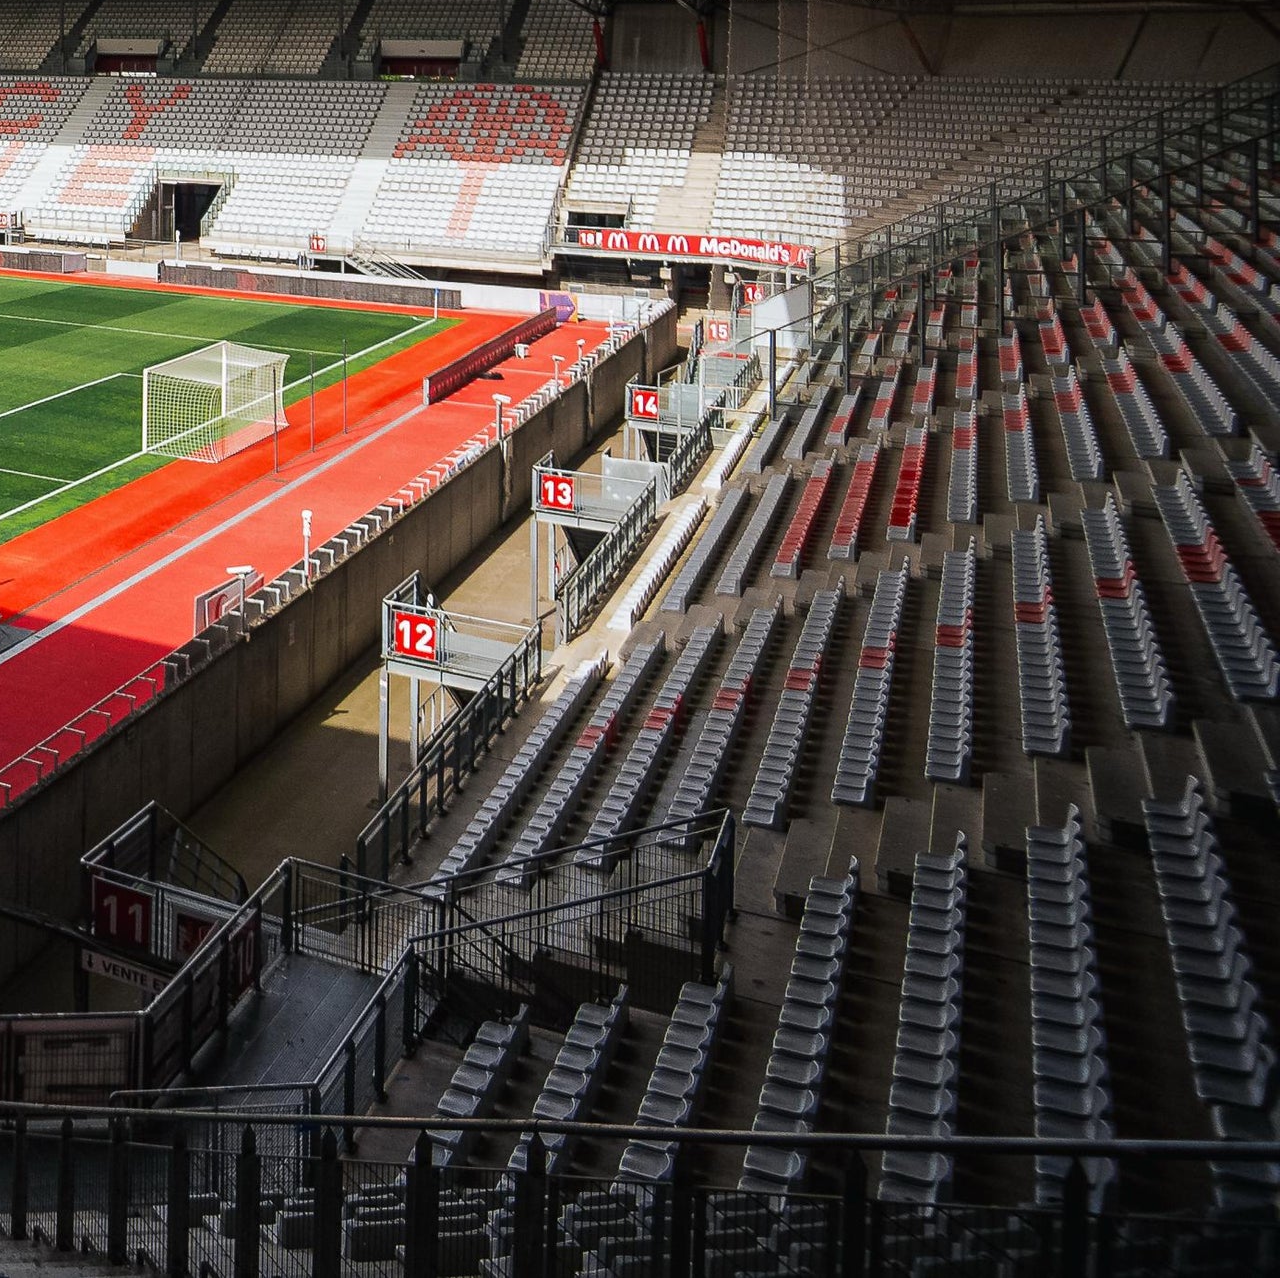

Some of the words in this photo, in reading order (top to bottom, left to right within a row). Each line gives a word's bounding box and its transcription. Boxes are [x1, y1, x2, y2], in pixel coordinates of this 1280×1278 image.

[312, 239, 324, 250] 19
[580, 232, 594, 245] 18
[699, 237, 790, 262] McDonald's
[746, 287, 762, 300] 16
[709, 324, 728, 339] 15
[635, 394, 657, 414] 14
[543, 480, 572, 505] 13
[398, 619, 434, 652] 12
[102, 894, 144, 944] 11
[102, 960, 149, 986] VENTE
